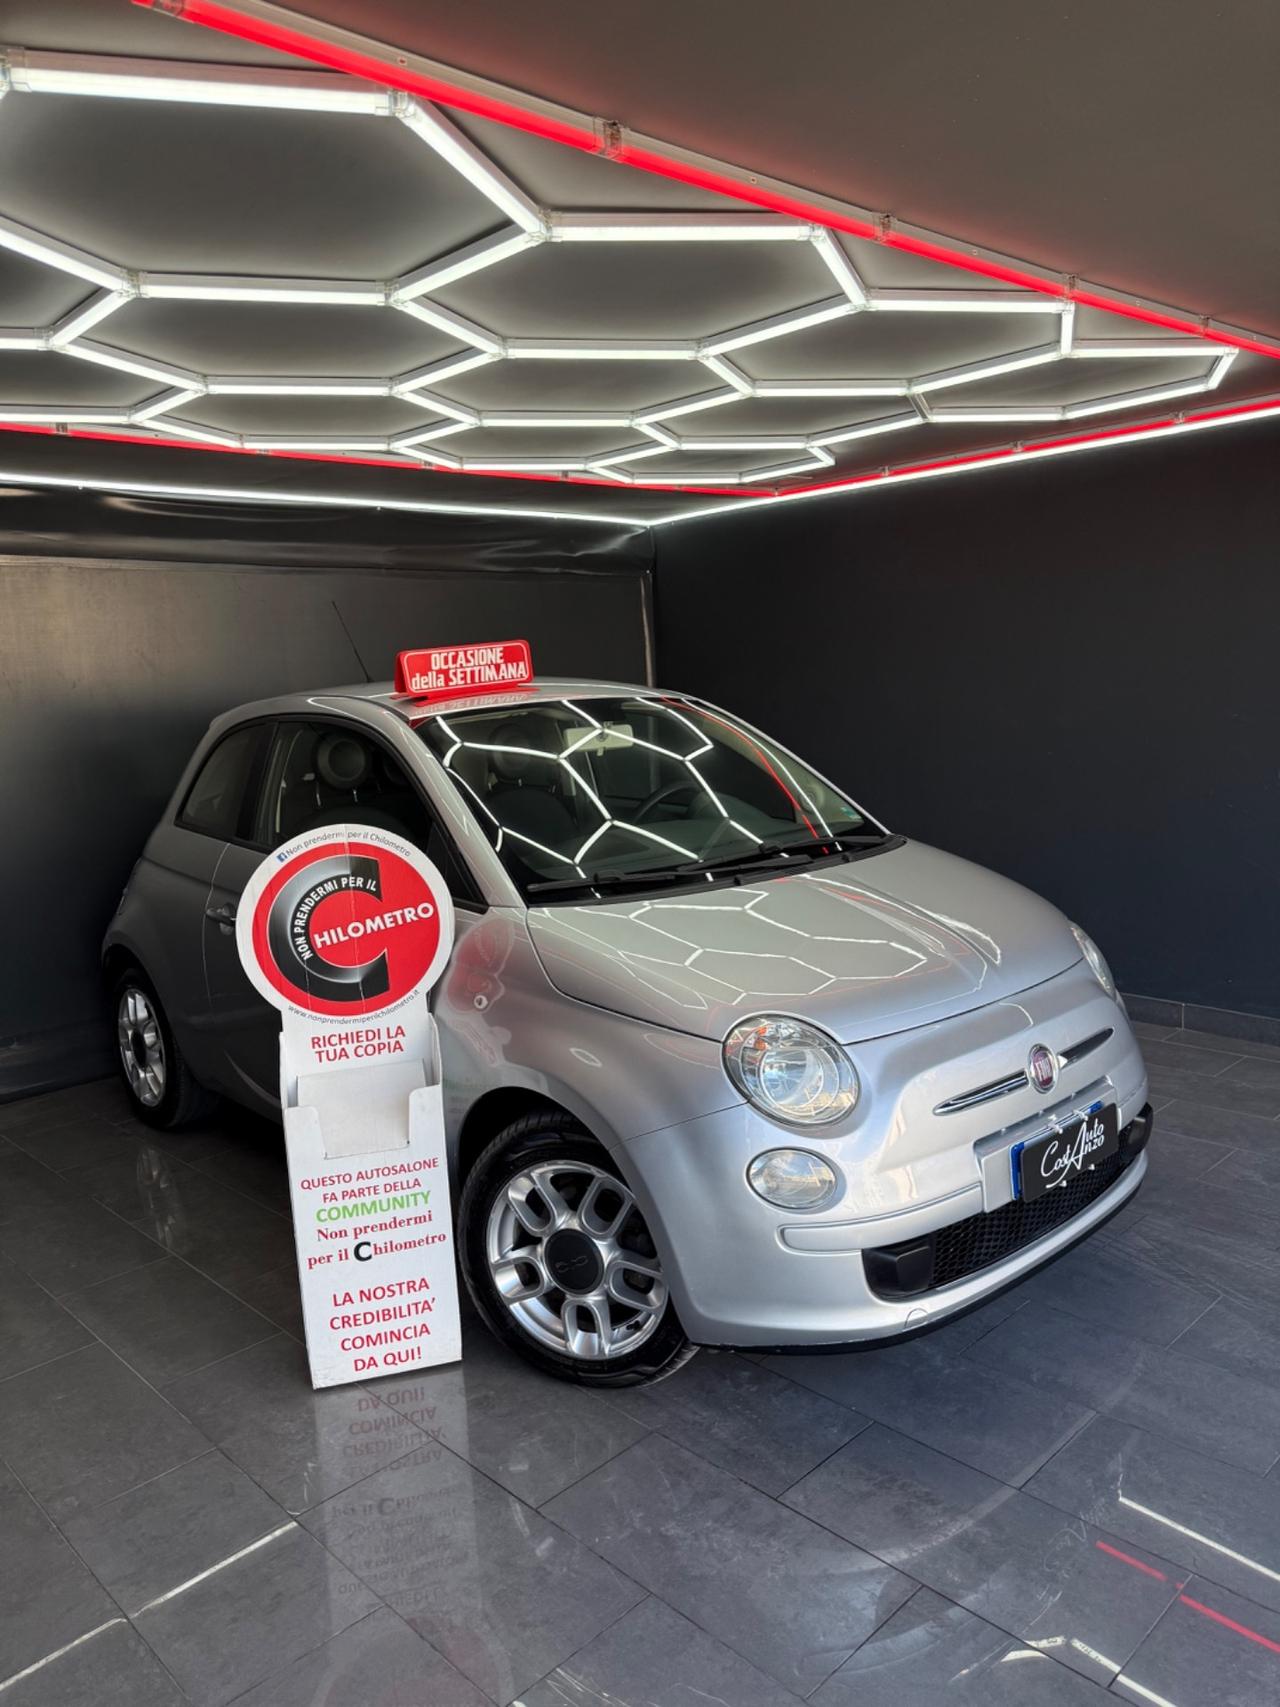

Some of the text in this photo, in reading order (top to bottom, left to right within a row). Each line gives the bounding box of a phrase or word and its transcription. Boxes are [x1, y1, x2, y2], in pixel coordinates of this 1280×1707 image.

[431, 647, 504, 670] OCCASIONE
[411, 661, 526, 690] della SETTIMANA
[294, 876, 377, 960] NON PRENDERMI PER IL
[311, 1025, 405, 1049] RICHIEDI LA
[315, 1040, 404, 1063] TUA COPIA
[300, 1157, 439, 1190] QUESTO AUTOSALONE
[322, 1178, 421, 1203] FA PARTE DELLA
[316, 1190, 431, 1223] COMMUNITY
[317, 1210, 433, 1242] Non prendermi
[307, 1233, 446, 1270] per il Chilometro
[333, 1278, 430, 1307] LA NOSTRA
[341, 1323, 430, 1351] COMINCIA
[354, 1346, 421, 1371] DA QUI!
